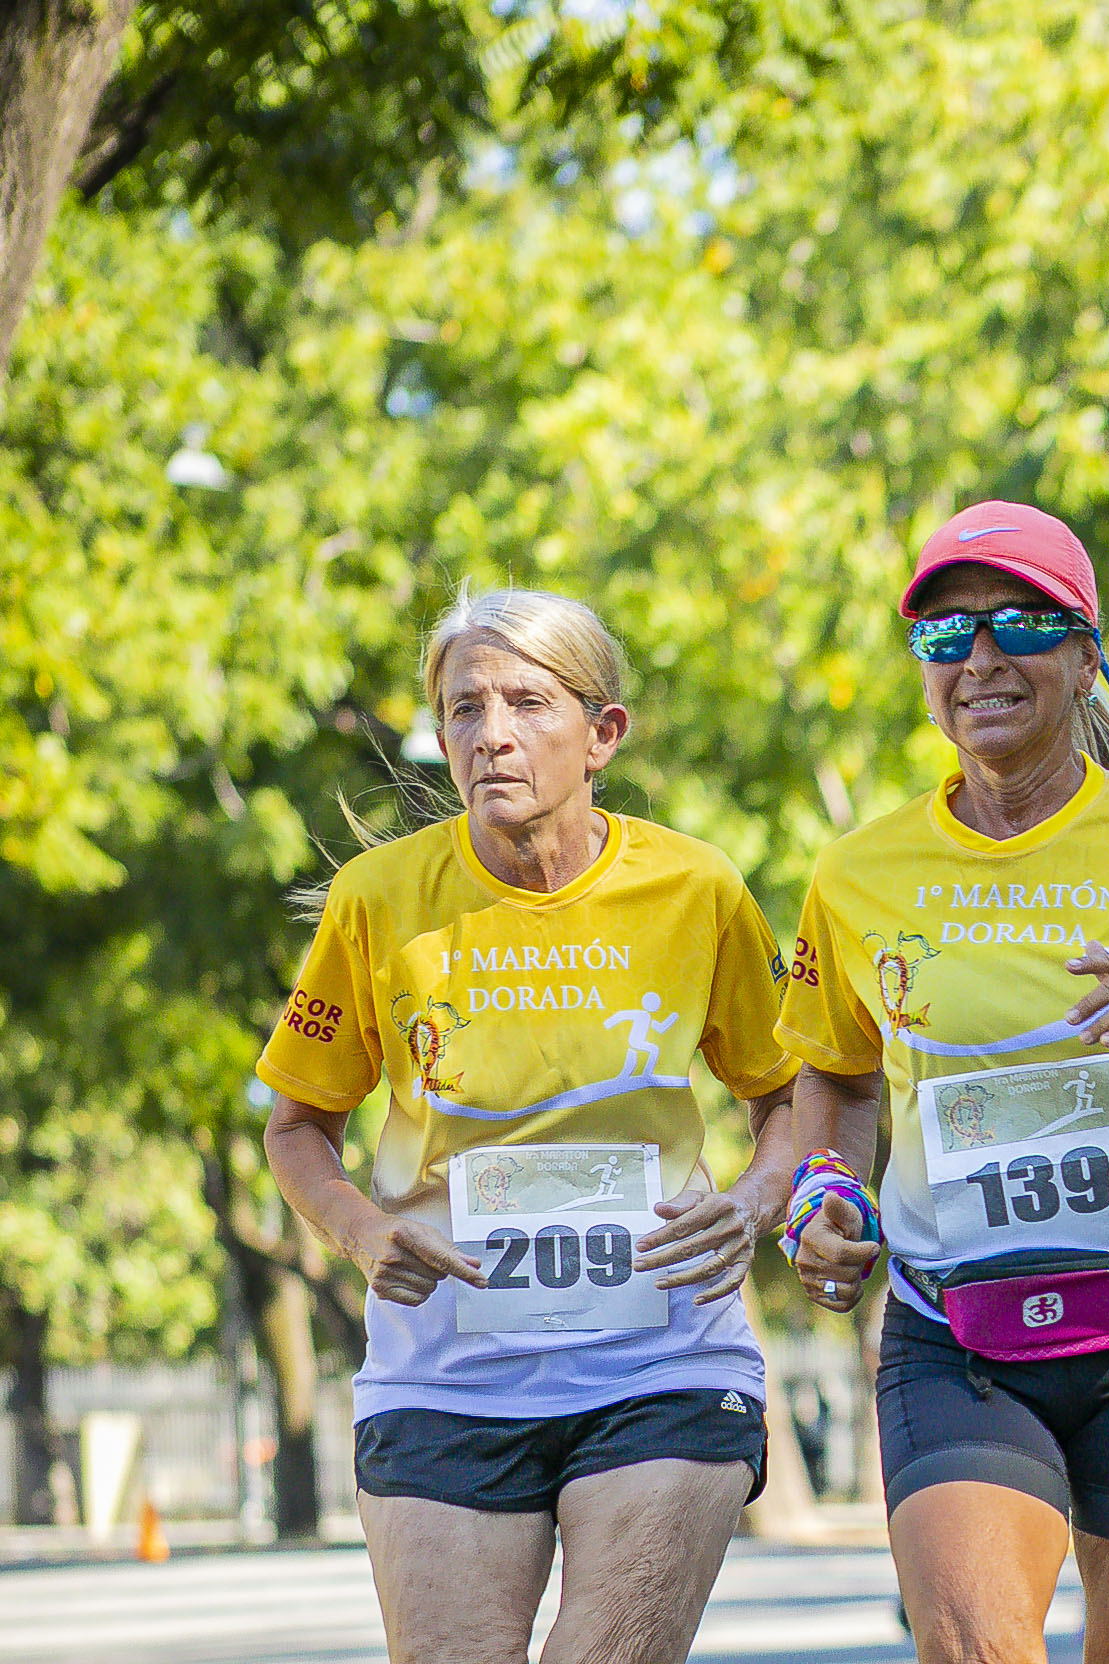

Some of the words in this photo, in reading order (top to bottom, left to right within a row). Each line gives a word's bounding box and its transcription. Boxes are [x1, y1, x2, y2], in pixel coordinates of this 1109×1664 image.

[940, 921, 1087, 946] DORADA
[472, 938, 631, 972] MARATÓN
[467, 985, 605, 1012] DORADA
[486, 1223, 632, 1289] 209
[721, 1402, 747, 1413] adidas
